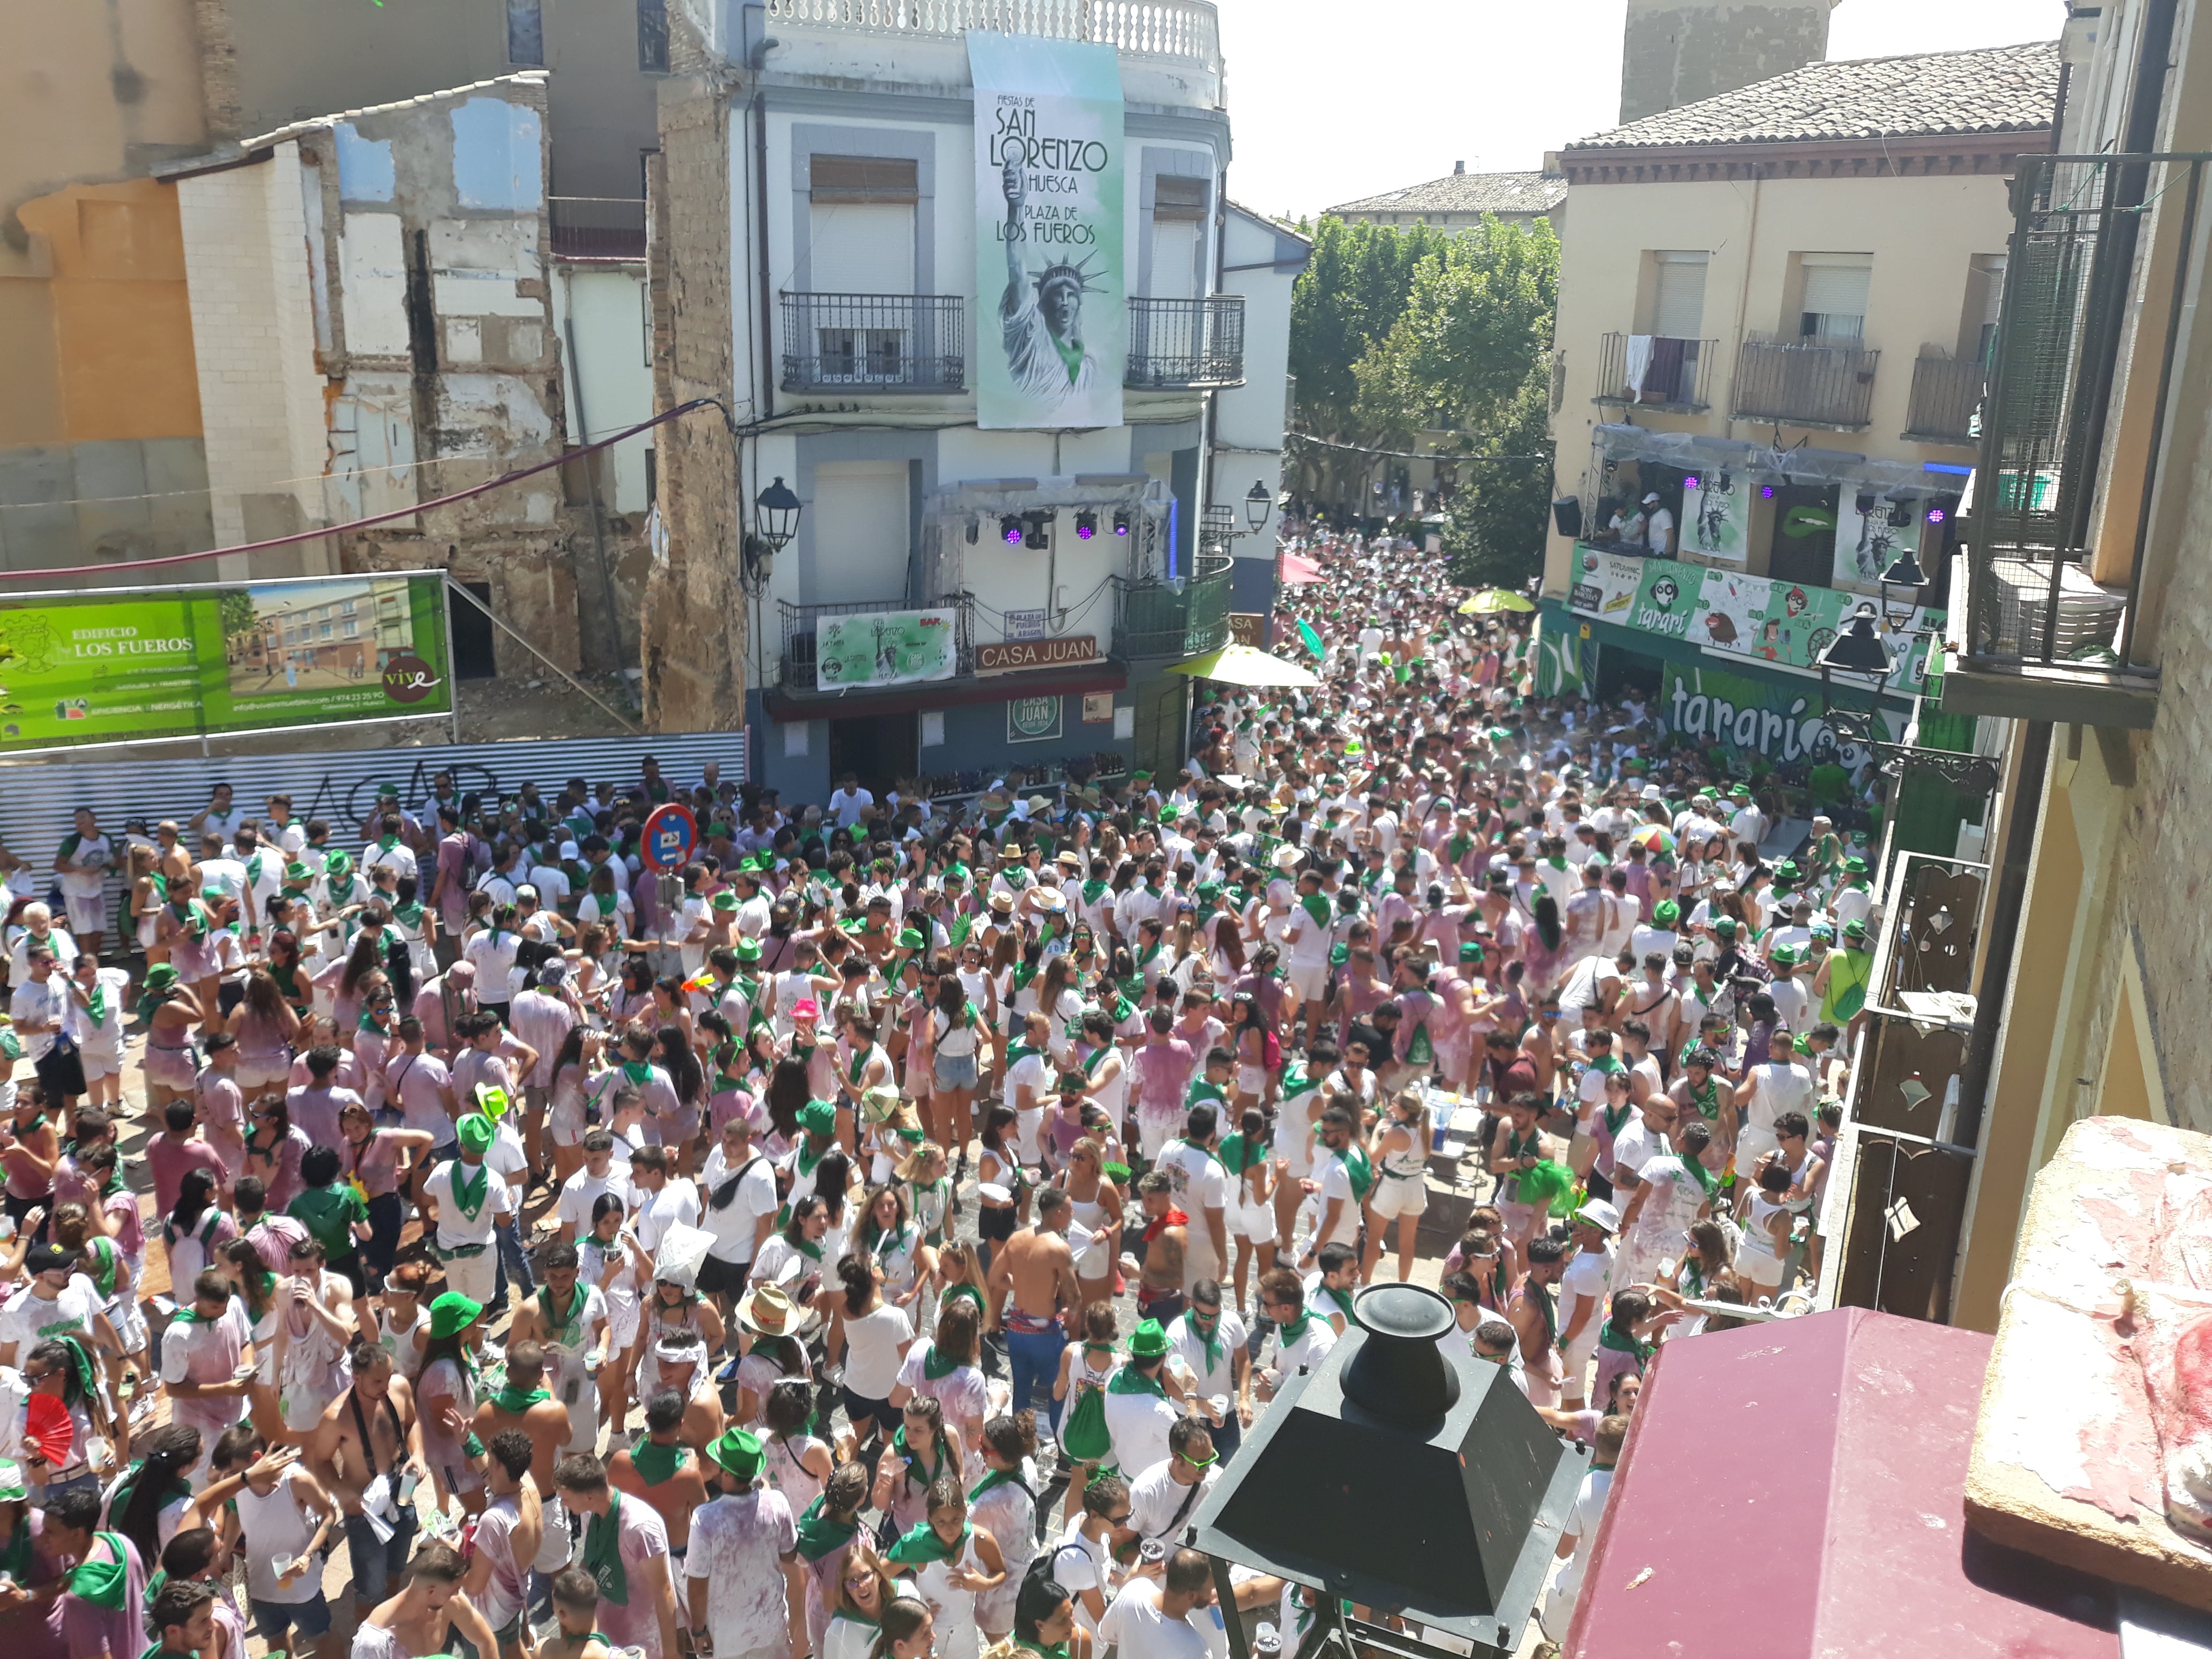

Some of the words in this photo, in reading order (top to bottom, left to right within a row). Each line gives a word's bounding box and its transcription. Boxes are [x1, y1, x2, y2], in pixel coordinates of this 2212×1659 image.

[997, 95, 1022, 107] FIESTAS
[1025, 98, 1035, 107] DE
[996, 107, 1035, 137] SAN
[990, 134, 1108, 172] LORENZO
[1029, 174, 1078, 193] HUESCA
[1025, 205, 1059, 219] PLAZA
[1065, 207, 1078, 220] DE
[997, 220, 1027, 241] LOS
[1034, 222, 1095, 244] FUEROS
[1666, 563, 1696, 585] LORENZO
[72, 626, 138, 640] EDIFICIO
[74, 642, 112, 657] LOS
[117, 637, 193, 655] FUEROS
[982, 645, 1037, 667] CASA
[1042, 640, 1094, 660] JUAN
[1020, 705, 1049, 723] JUAN
[1671, 676, 1806, 762] tararí
